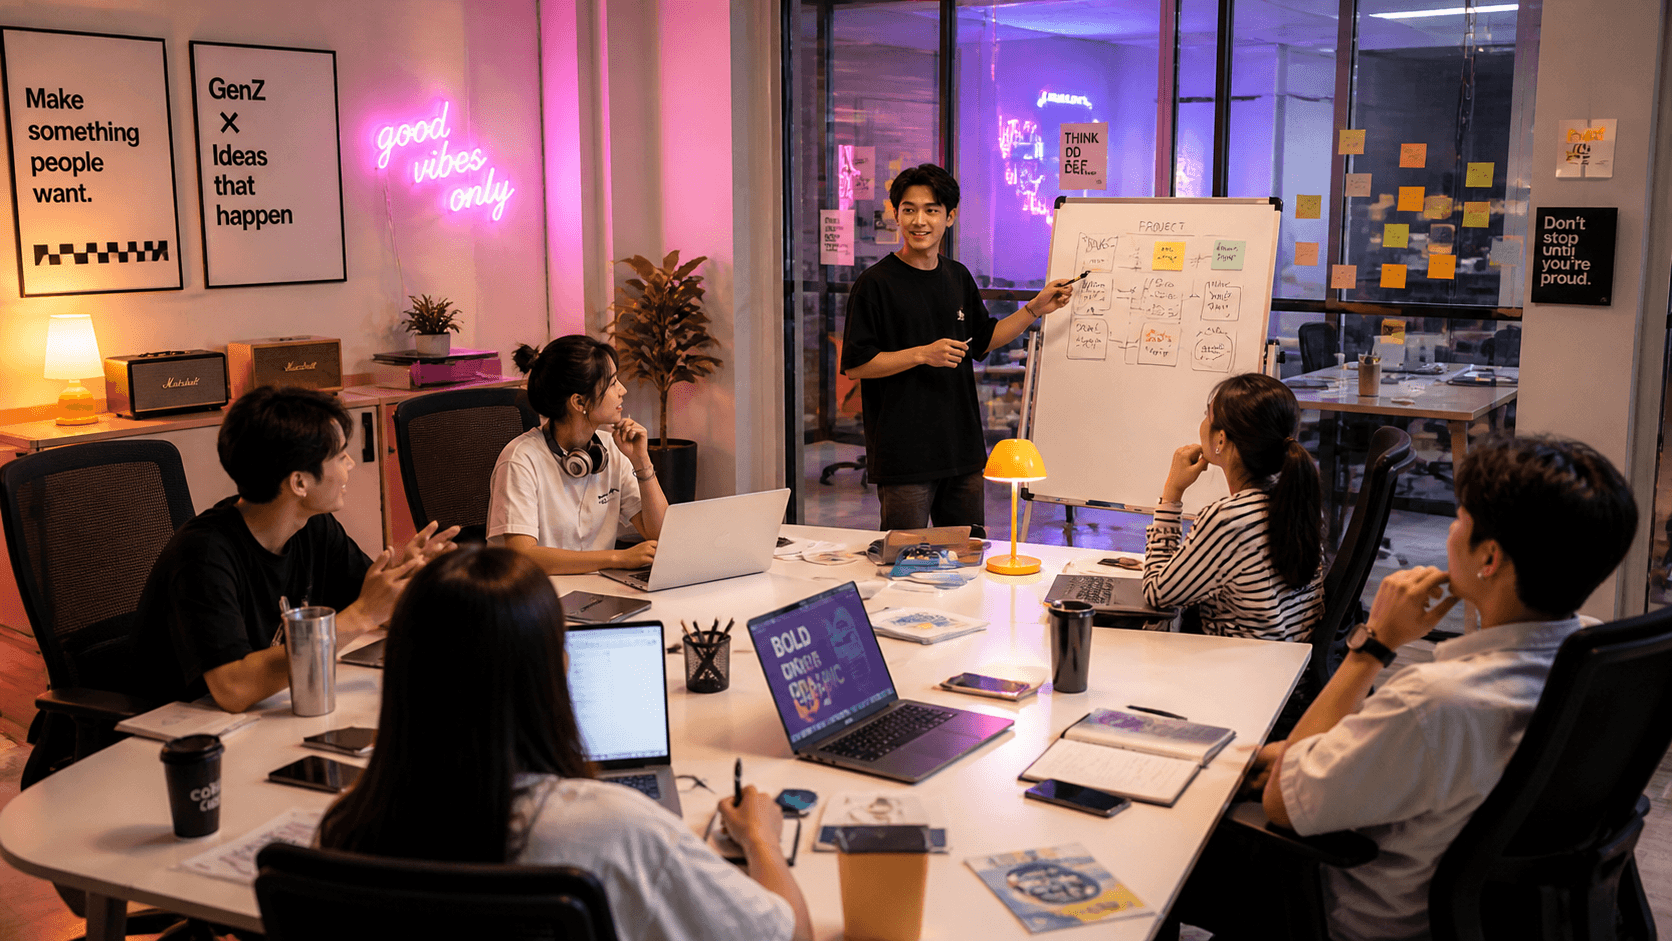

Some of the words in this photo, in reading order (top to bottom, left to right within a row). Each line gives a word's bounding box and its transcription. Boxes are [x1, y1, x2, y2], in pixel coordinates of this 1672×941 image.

[25, 87, 84, 110] Make
[208, 77, 266, 101] GenZ
[28, 121, 140, 147] something
[377, 101, 450, 169] good
[1065, 132, 1099, 144] THINK
[31, 151, 104, 177] people
[212, 144, 268, 166] Ideas
[414, 140, 487, 183] vibes
[33, 183, 92, 203] want.
[214, 174, 256, 196] that
[450, 167, 515, 221] only
[216, 204, 293, 230] happen
[1544, 215, 1586, 230] Don't
[1543, 232, 1579, 247] stop
[1542, 244, 1576, 259] until
[1541, 257, 1591, 272] you're
[1540, 272, 1592, 287] proud.
[770, 625, 812, 658] BOLD
